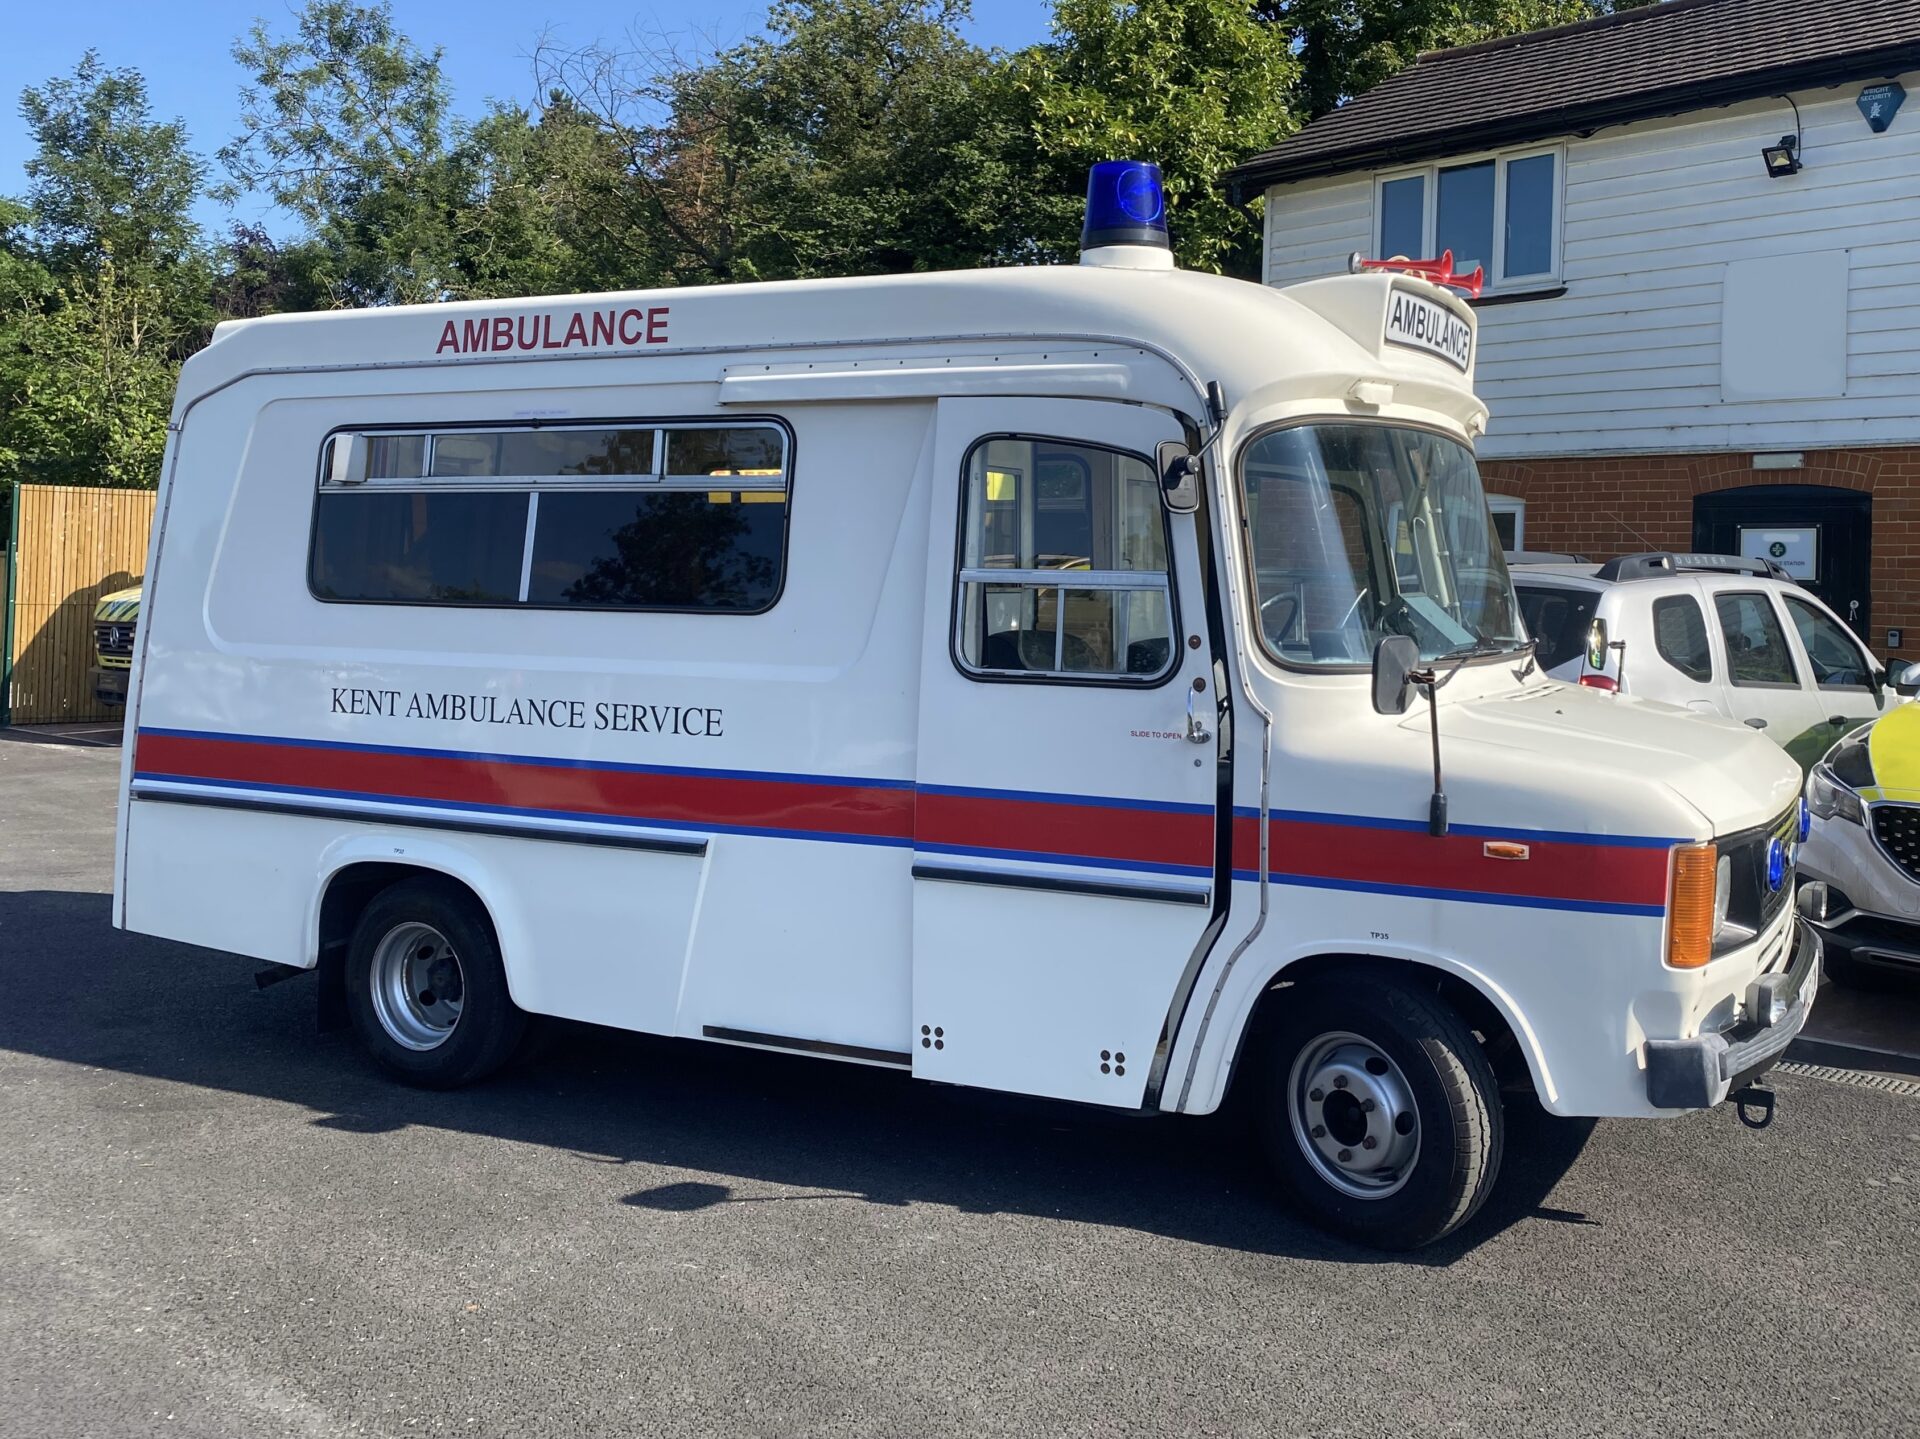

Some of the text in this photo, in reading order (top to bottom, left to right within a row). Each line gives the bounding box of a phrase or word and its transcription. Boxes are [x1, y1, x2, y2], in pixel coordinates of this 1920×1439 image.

[1863, 86, 1889, 95] WRIGHT
[1860, 92, 1892, 101] SECURITY
[436, 307, 670, 354] AMBULANCE
[1390, 295, 1470, 361] AMBULANCE
[1674, 556, 1727, 566] DUSTER
[331, 687, 724, 737] KENT AMBULANCE SERVICE
[1130, 730, 1150, 738] SLIDE
[1162, 732, 1182, 740] OPEN
[1370, 931, 1389, 940] TP35
